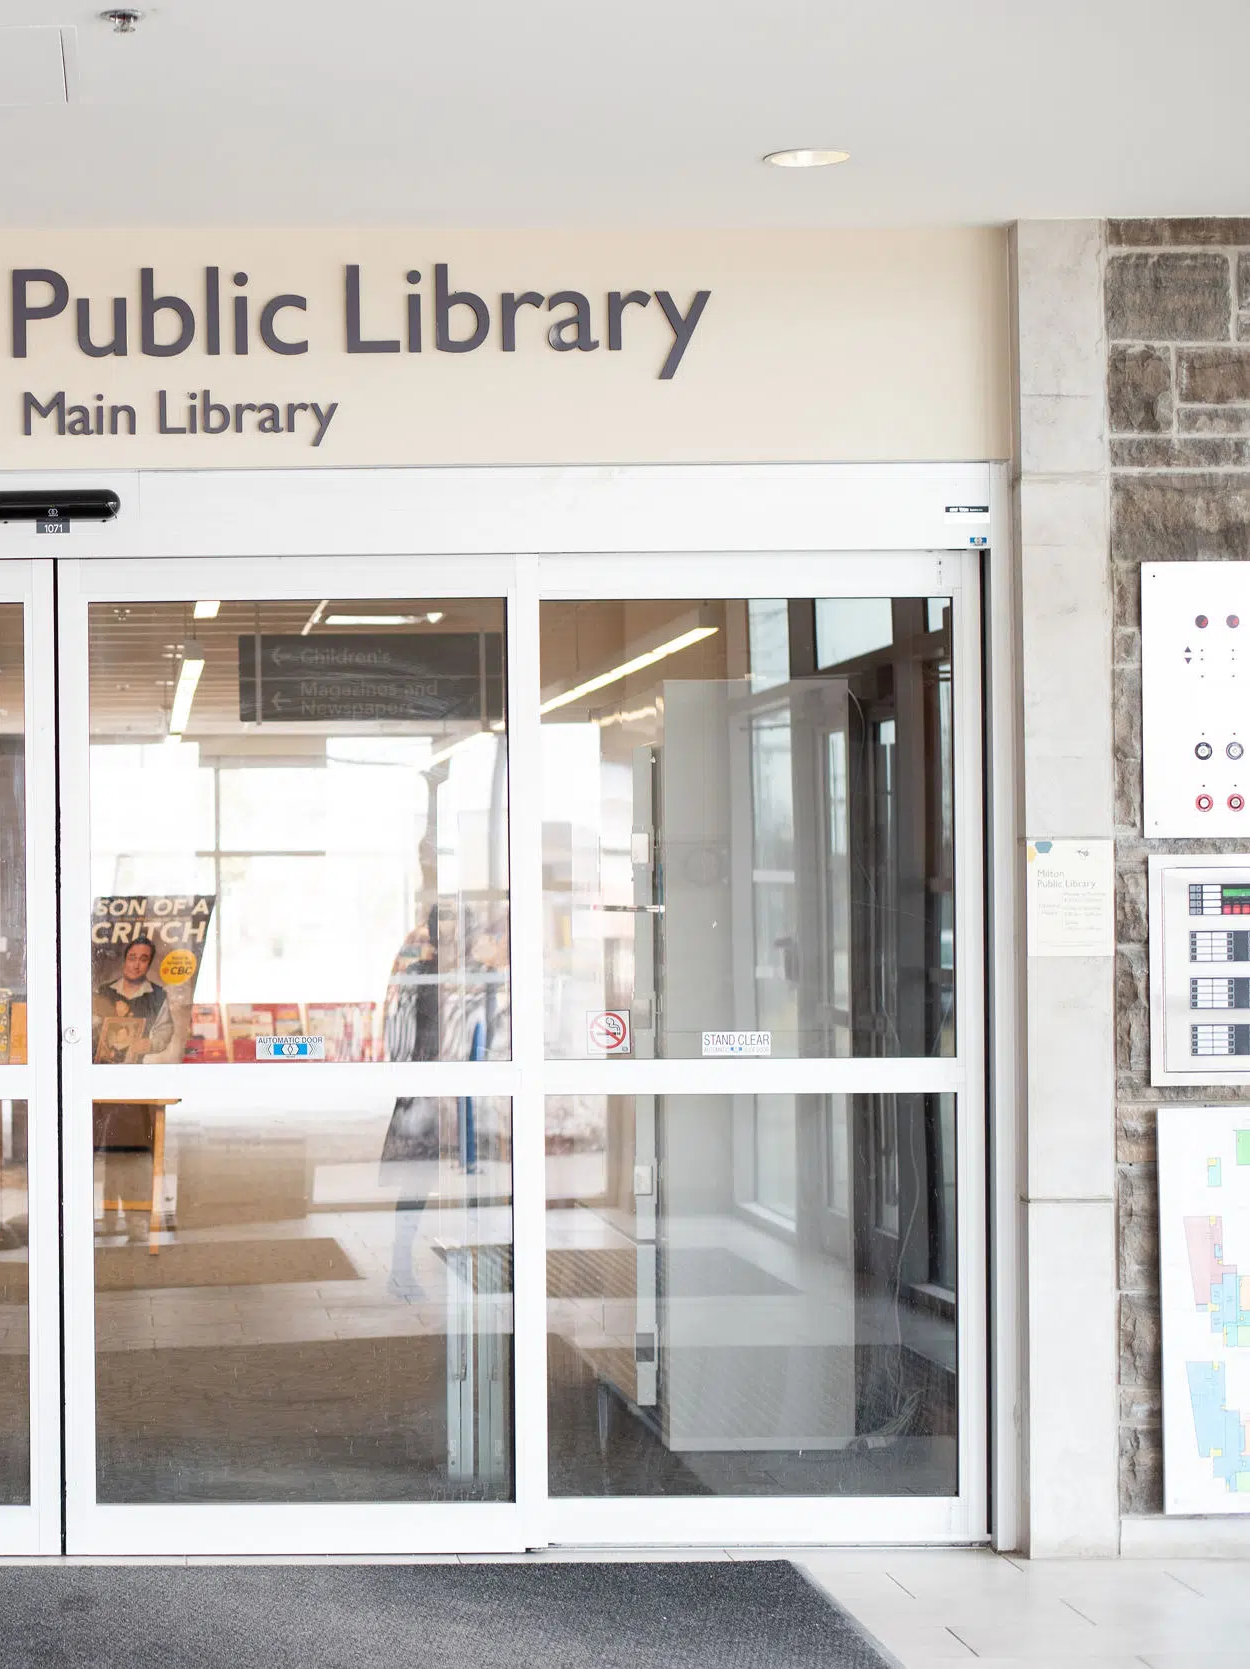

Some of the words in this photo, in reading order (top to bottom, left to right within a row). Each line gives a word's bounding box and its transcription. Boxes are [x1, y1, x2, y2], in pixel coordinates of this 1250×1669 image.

[12, 266, 308, 358] Public
[345, 264, 711, 379] Library
[23, 392, 136, 435] Main
[159, 390, 338, 446] Library
[44, 524, 63, 533] 1071
[300, 648, 390, 664] Children's
[300, 680, 397, 700] Magazines
[404, 679, 438, 696] and
[1037, 869, 1065, 878] Milton
[1037, 879, 1063, 888] Public
[1065, 879, 1096, 889] Library
[95, 899, 147, 916] SON
[153, 899, 187, 916] OF
[191, 899, 209, 915] A
[91, 921, 206, 943] CRITCH
[170, 966, 193, 976] CBC
[258, 1036, 300, 1044] AUTOMATIC
[301, 1036, 323, 1044] DOOR
[704, 1034, 735, 1046] STAND
[738, 1034, 769, 1046] CLEAR
